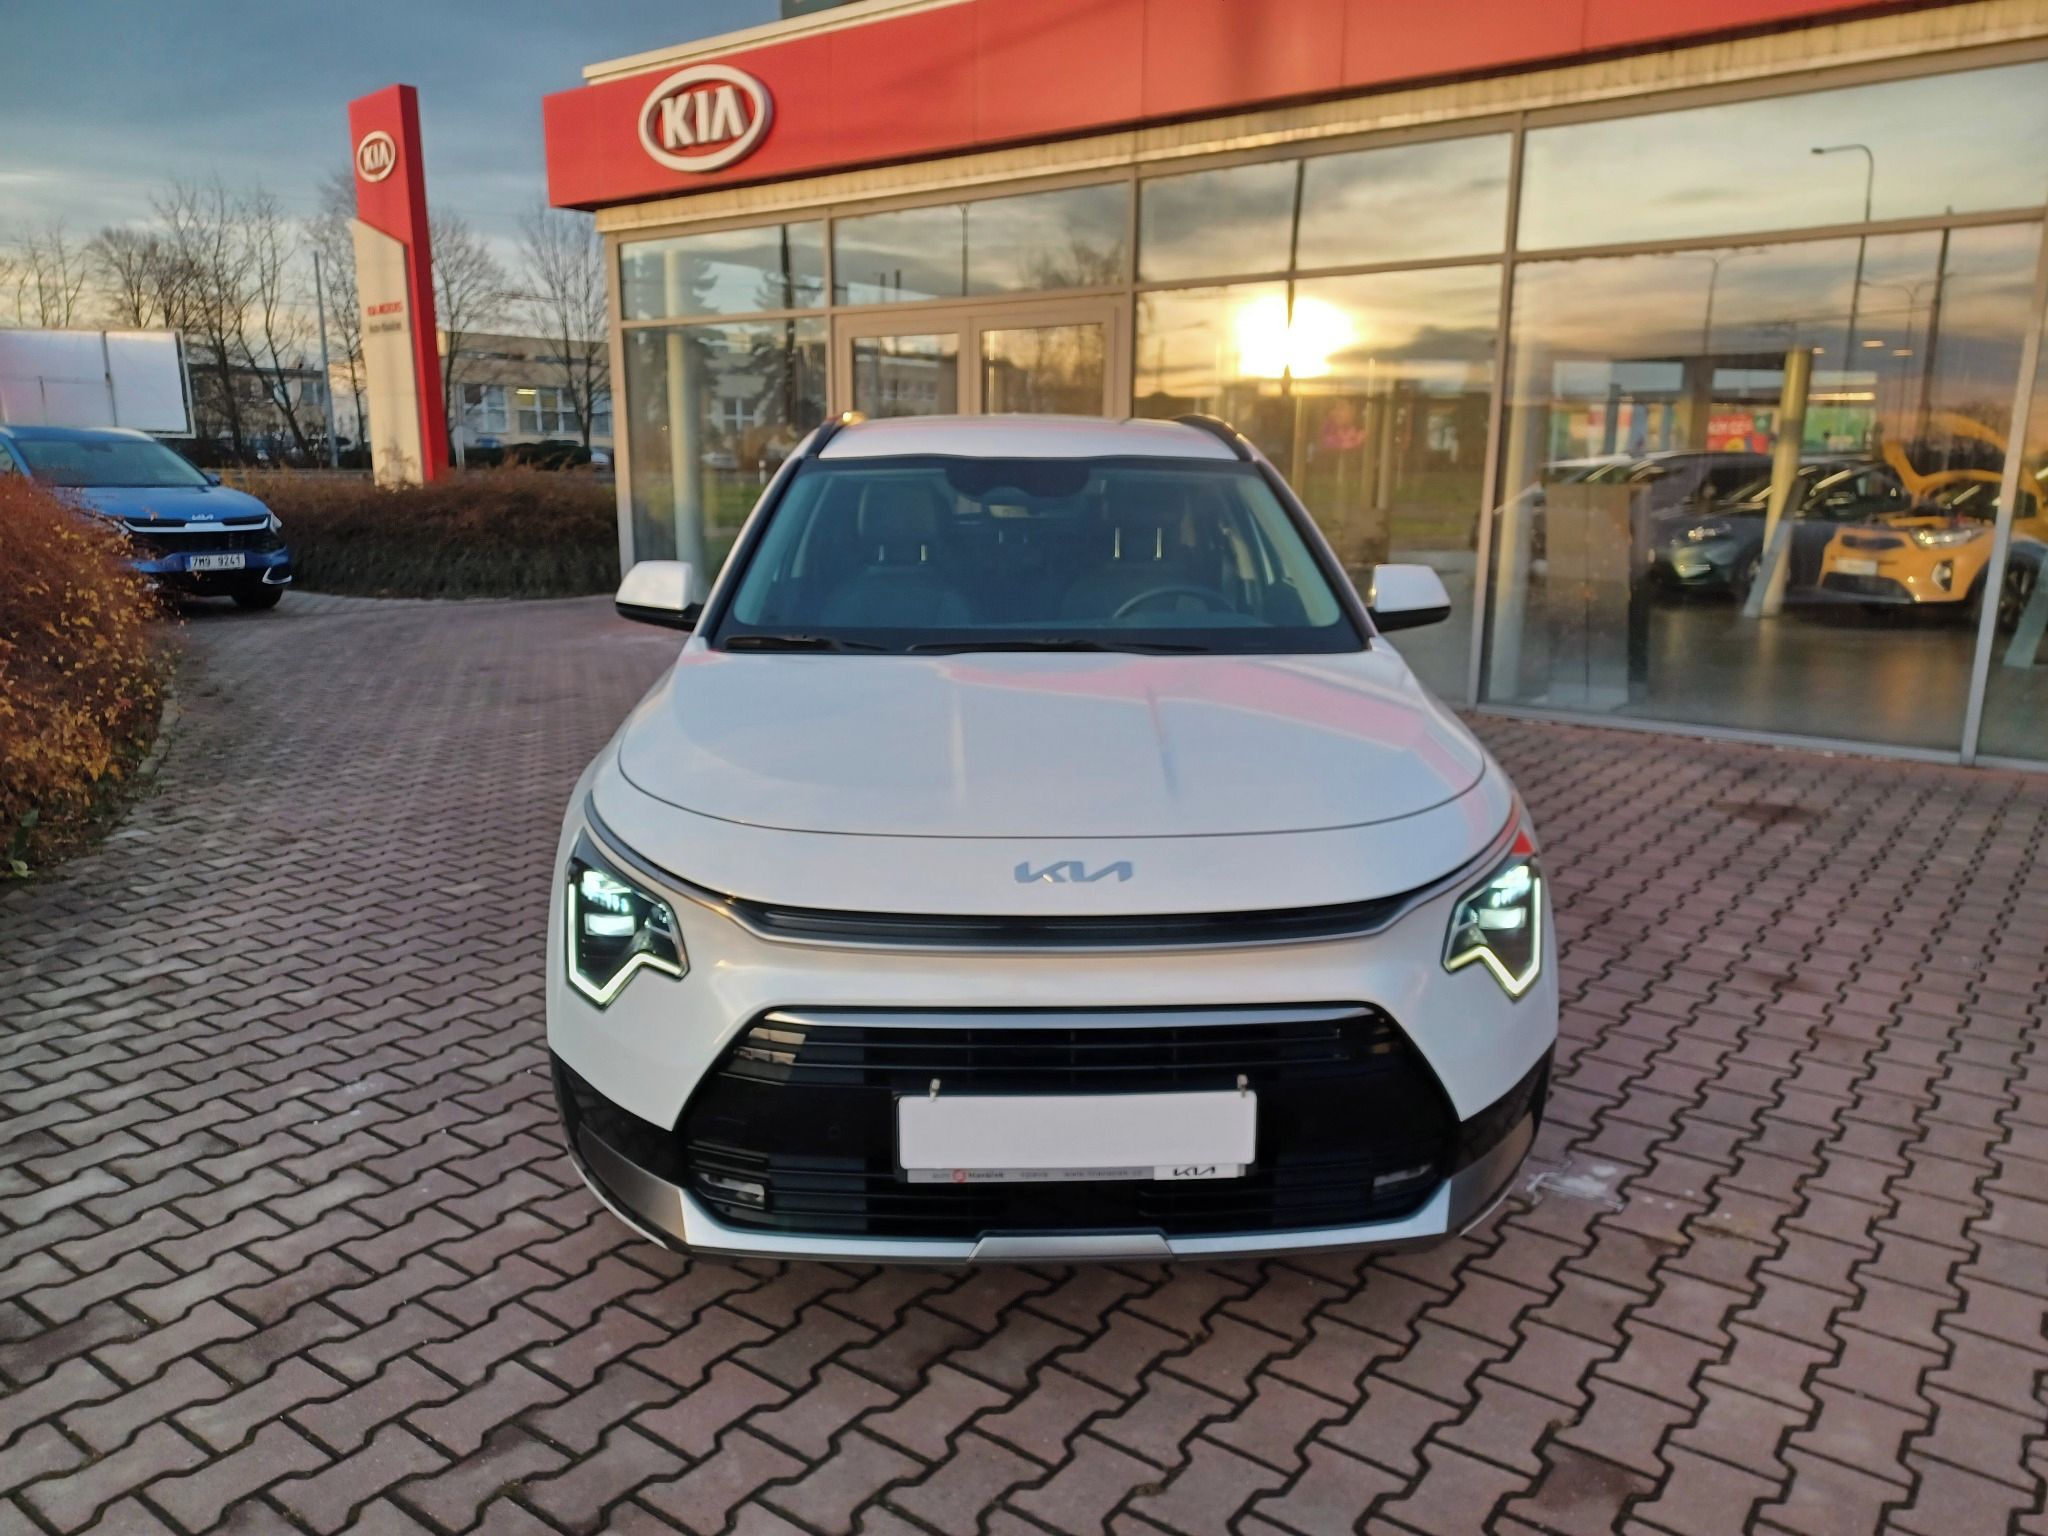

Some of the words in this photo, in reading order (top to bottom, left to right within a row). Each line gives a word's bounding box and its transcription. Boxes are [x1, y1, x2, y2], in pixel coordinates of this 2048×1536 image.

[660, 85, 746, 150] KIA
[363, 141, 391, 171] KIA
[217, 554, 241, 567] 9241
[1014, 861, 1133, 883] KIA
[1173, 1166, 1216, 1177] KIA
